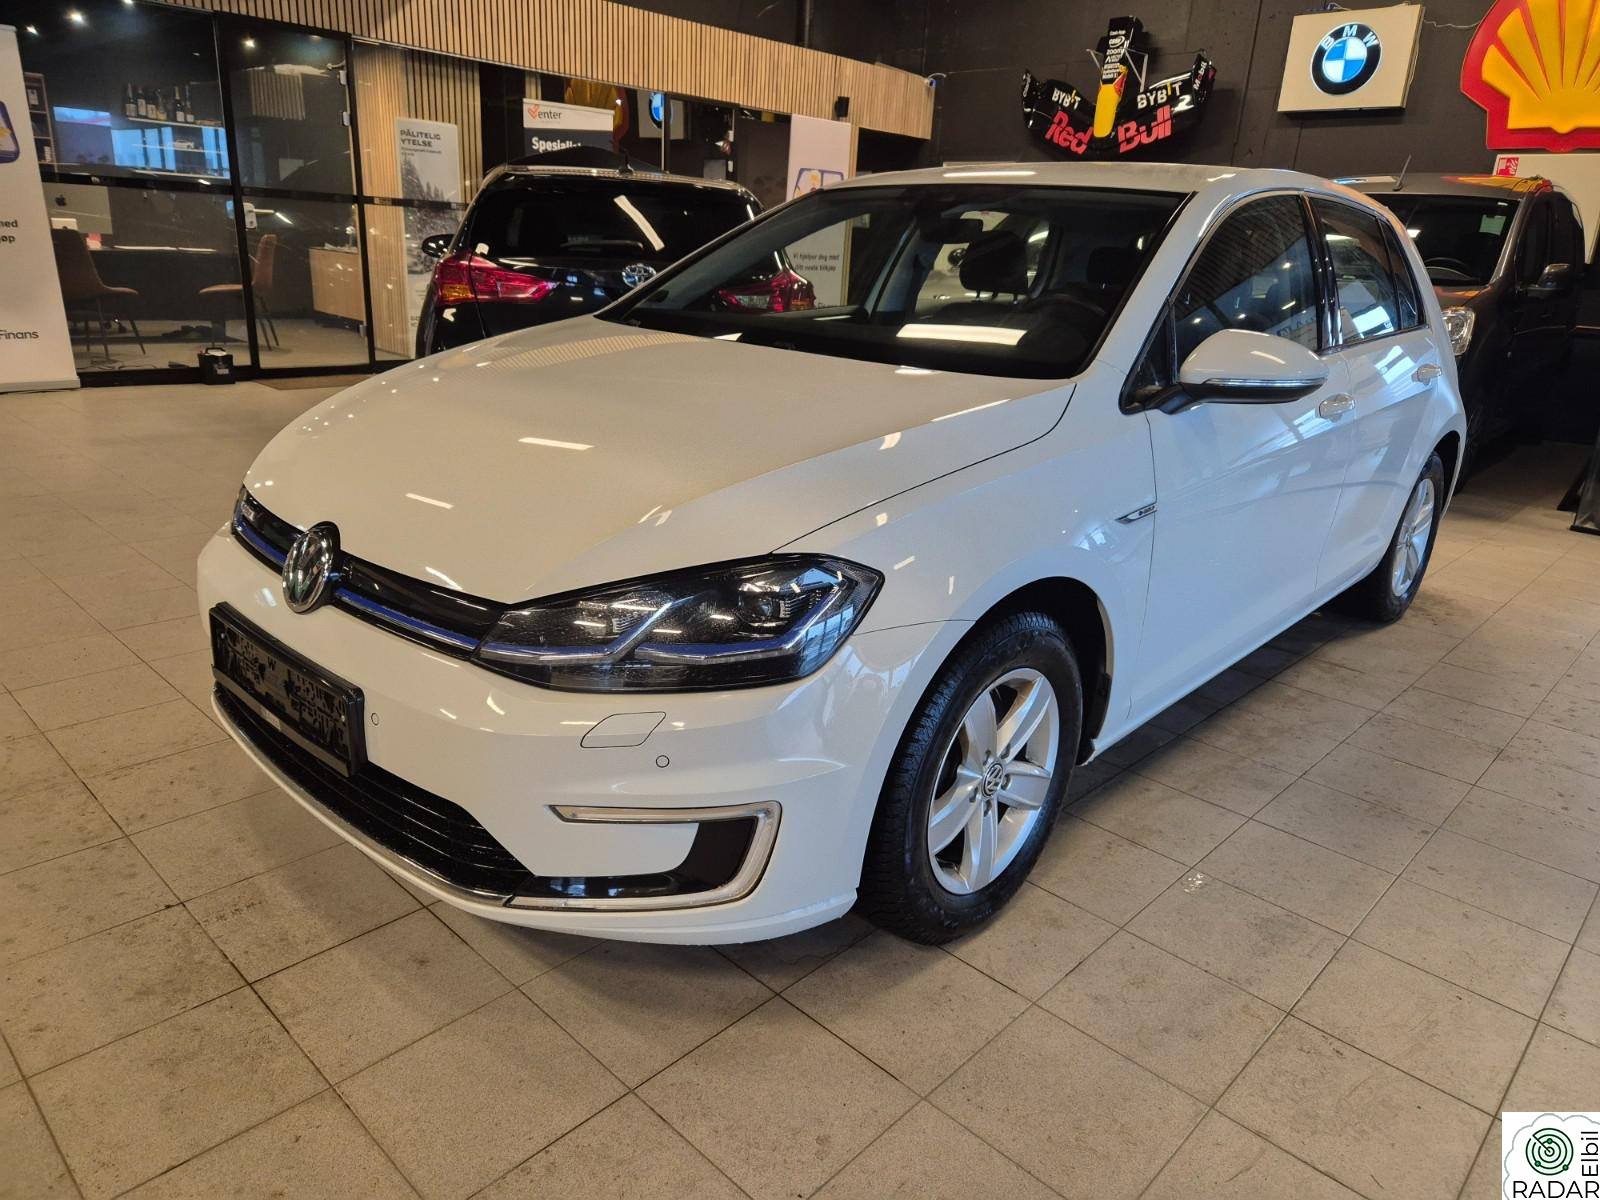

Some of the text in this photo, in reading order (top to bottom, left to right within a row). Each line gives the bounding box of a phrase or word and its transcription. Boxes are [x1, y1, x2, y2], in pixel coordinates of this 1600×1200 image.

[1321, 24, 1380, 50] BMW
[1137, 82, 1183, 109] BYBIT
[1044, 104, 1172, 154] Red Bull
[400, 138, 432, 147] YTELSE
